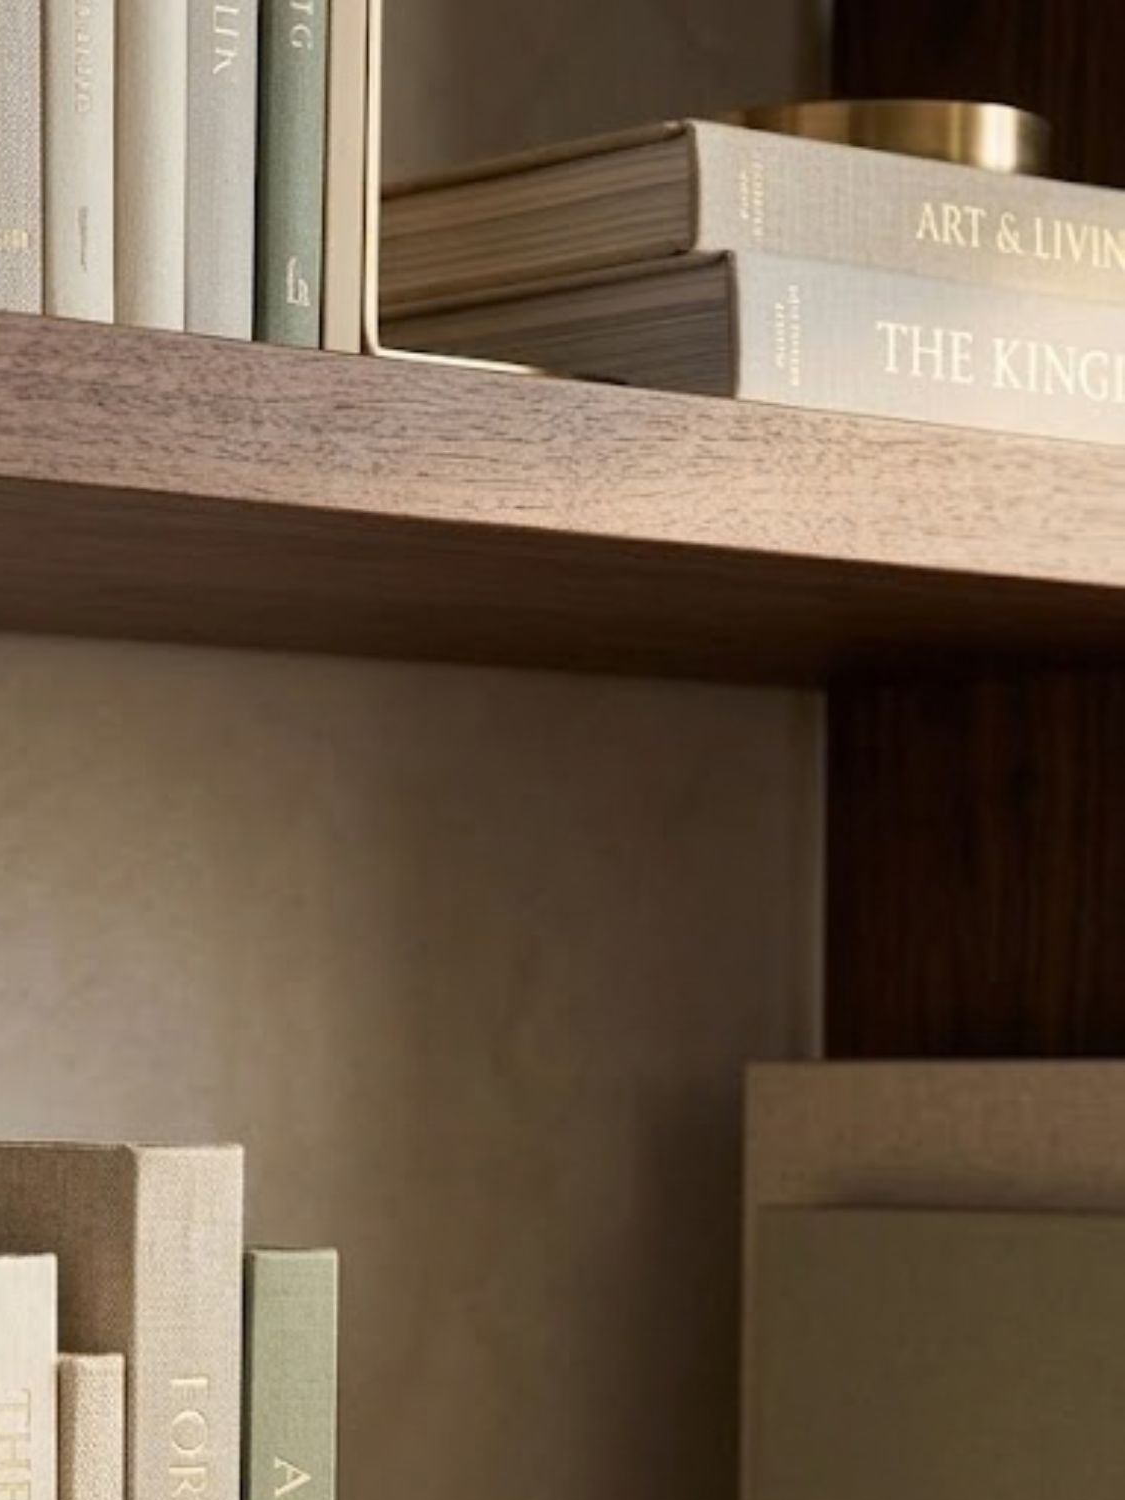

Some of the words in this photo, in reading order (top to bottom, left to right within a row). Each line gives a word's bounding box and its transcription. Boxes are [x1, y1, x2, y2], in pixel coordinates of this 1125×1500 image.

[916, 202, 987, 248] ART
[996, 211, 1024, 255] &
[876, 320, 974, 384] THE
